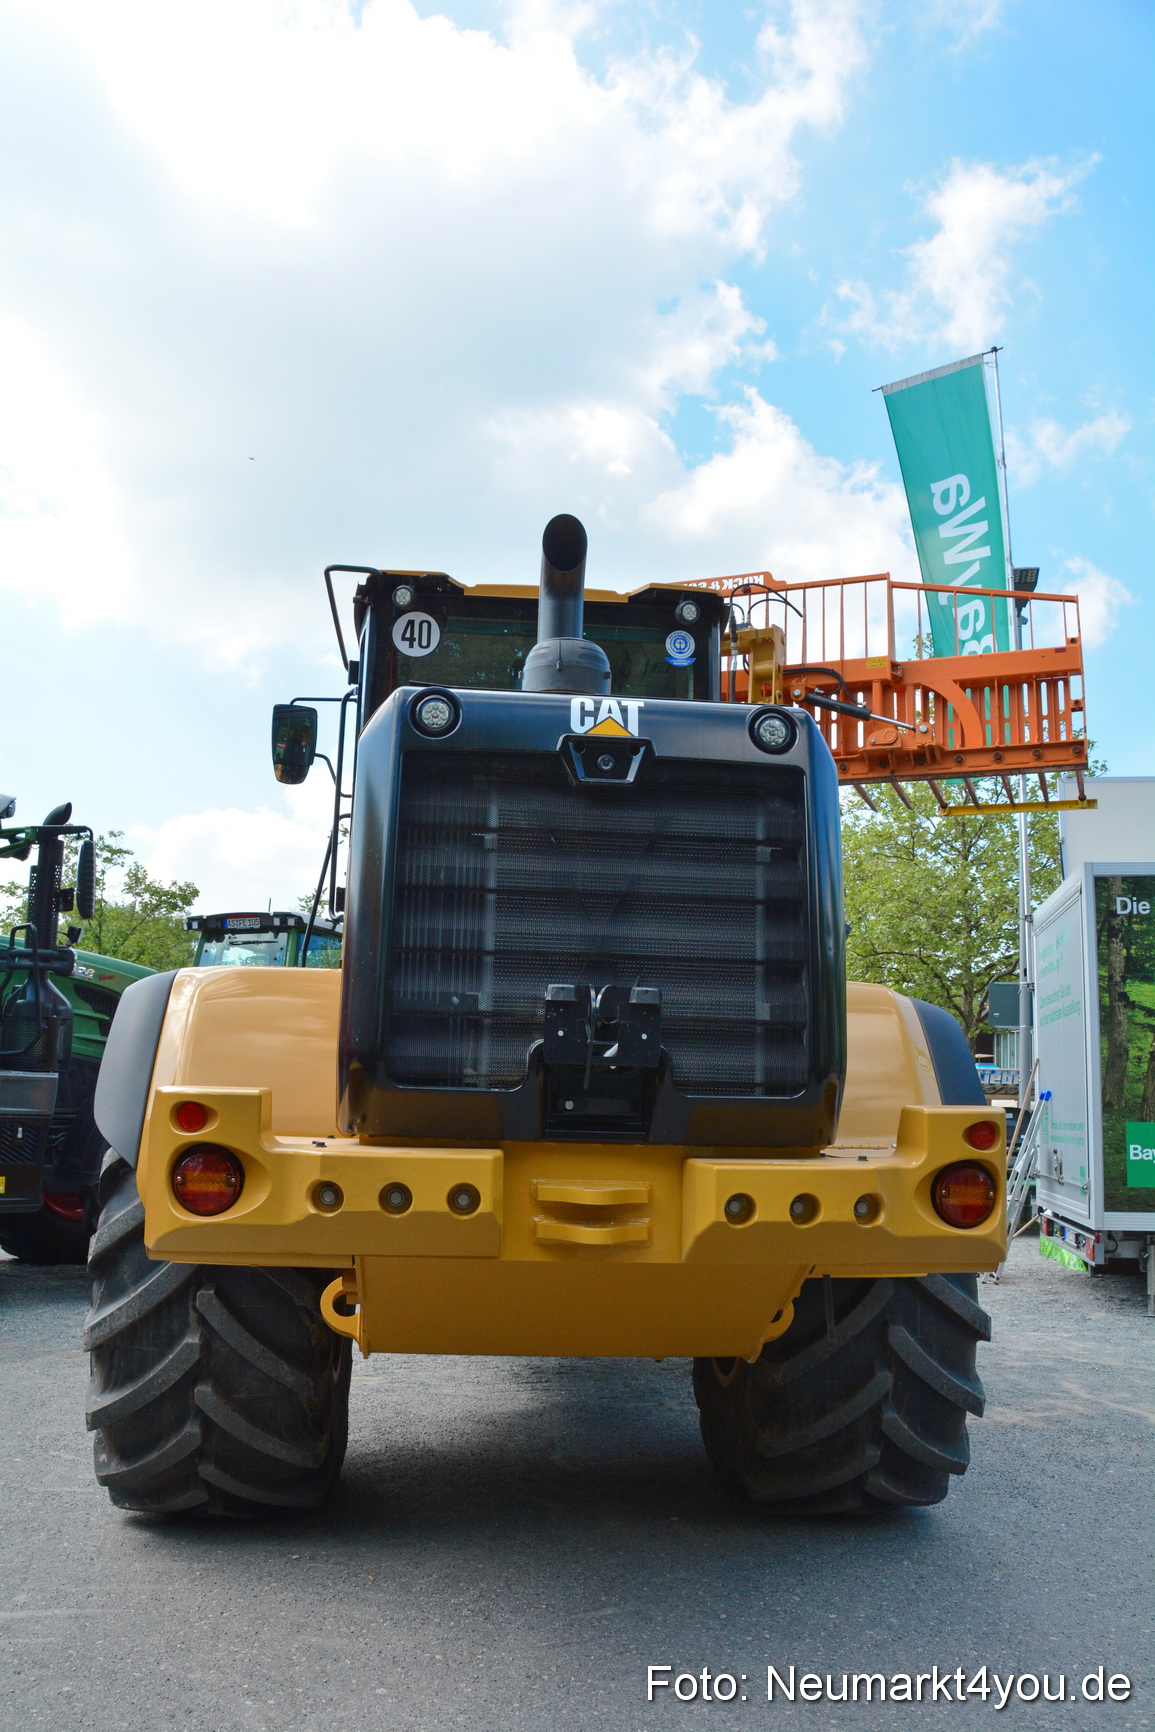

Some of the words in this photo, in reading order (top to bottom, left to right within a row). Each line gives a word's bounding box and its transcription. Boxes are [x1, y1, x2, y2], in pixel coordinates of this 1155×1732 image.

[400, 619, 432, 649] 40
[570, 697, 645, 737] CAT
[1115, 896, 1151, 915] Die
